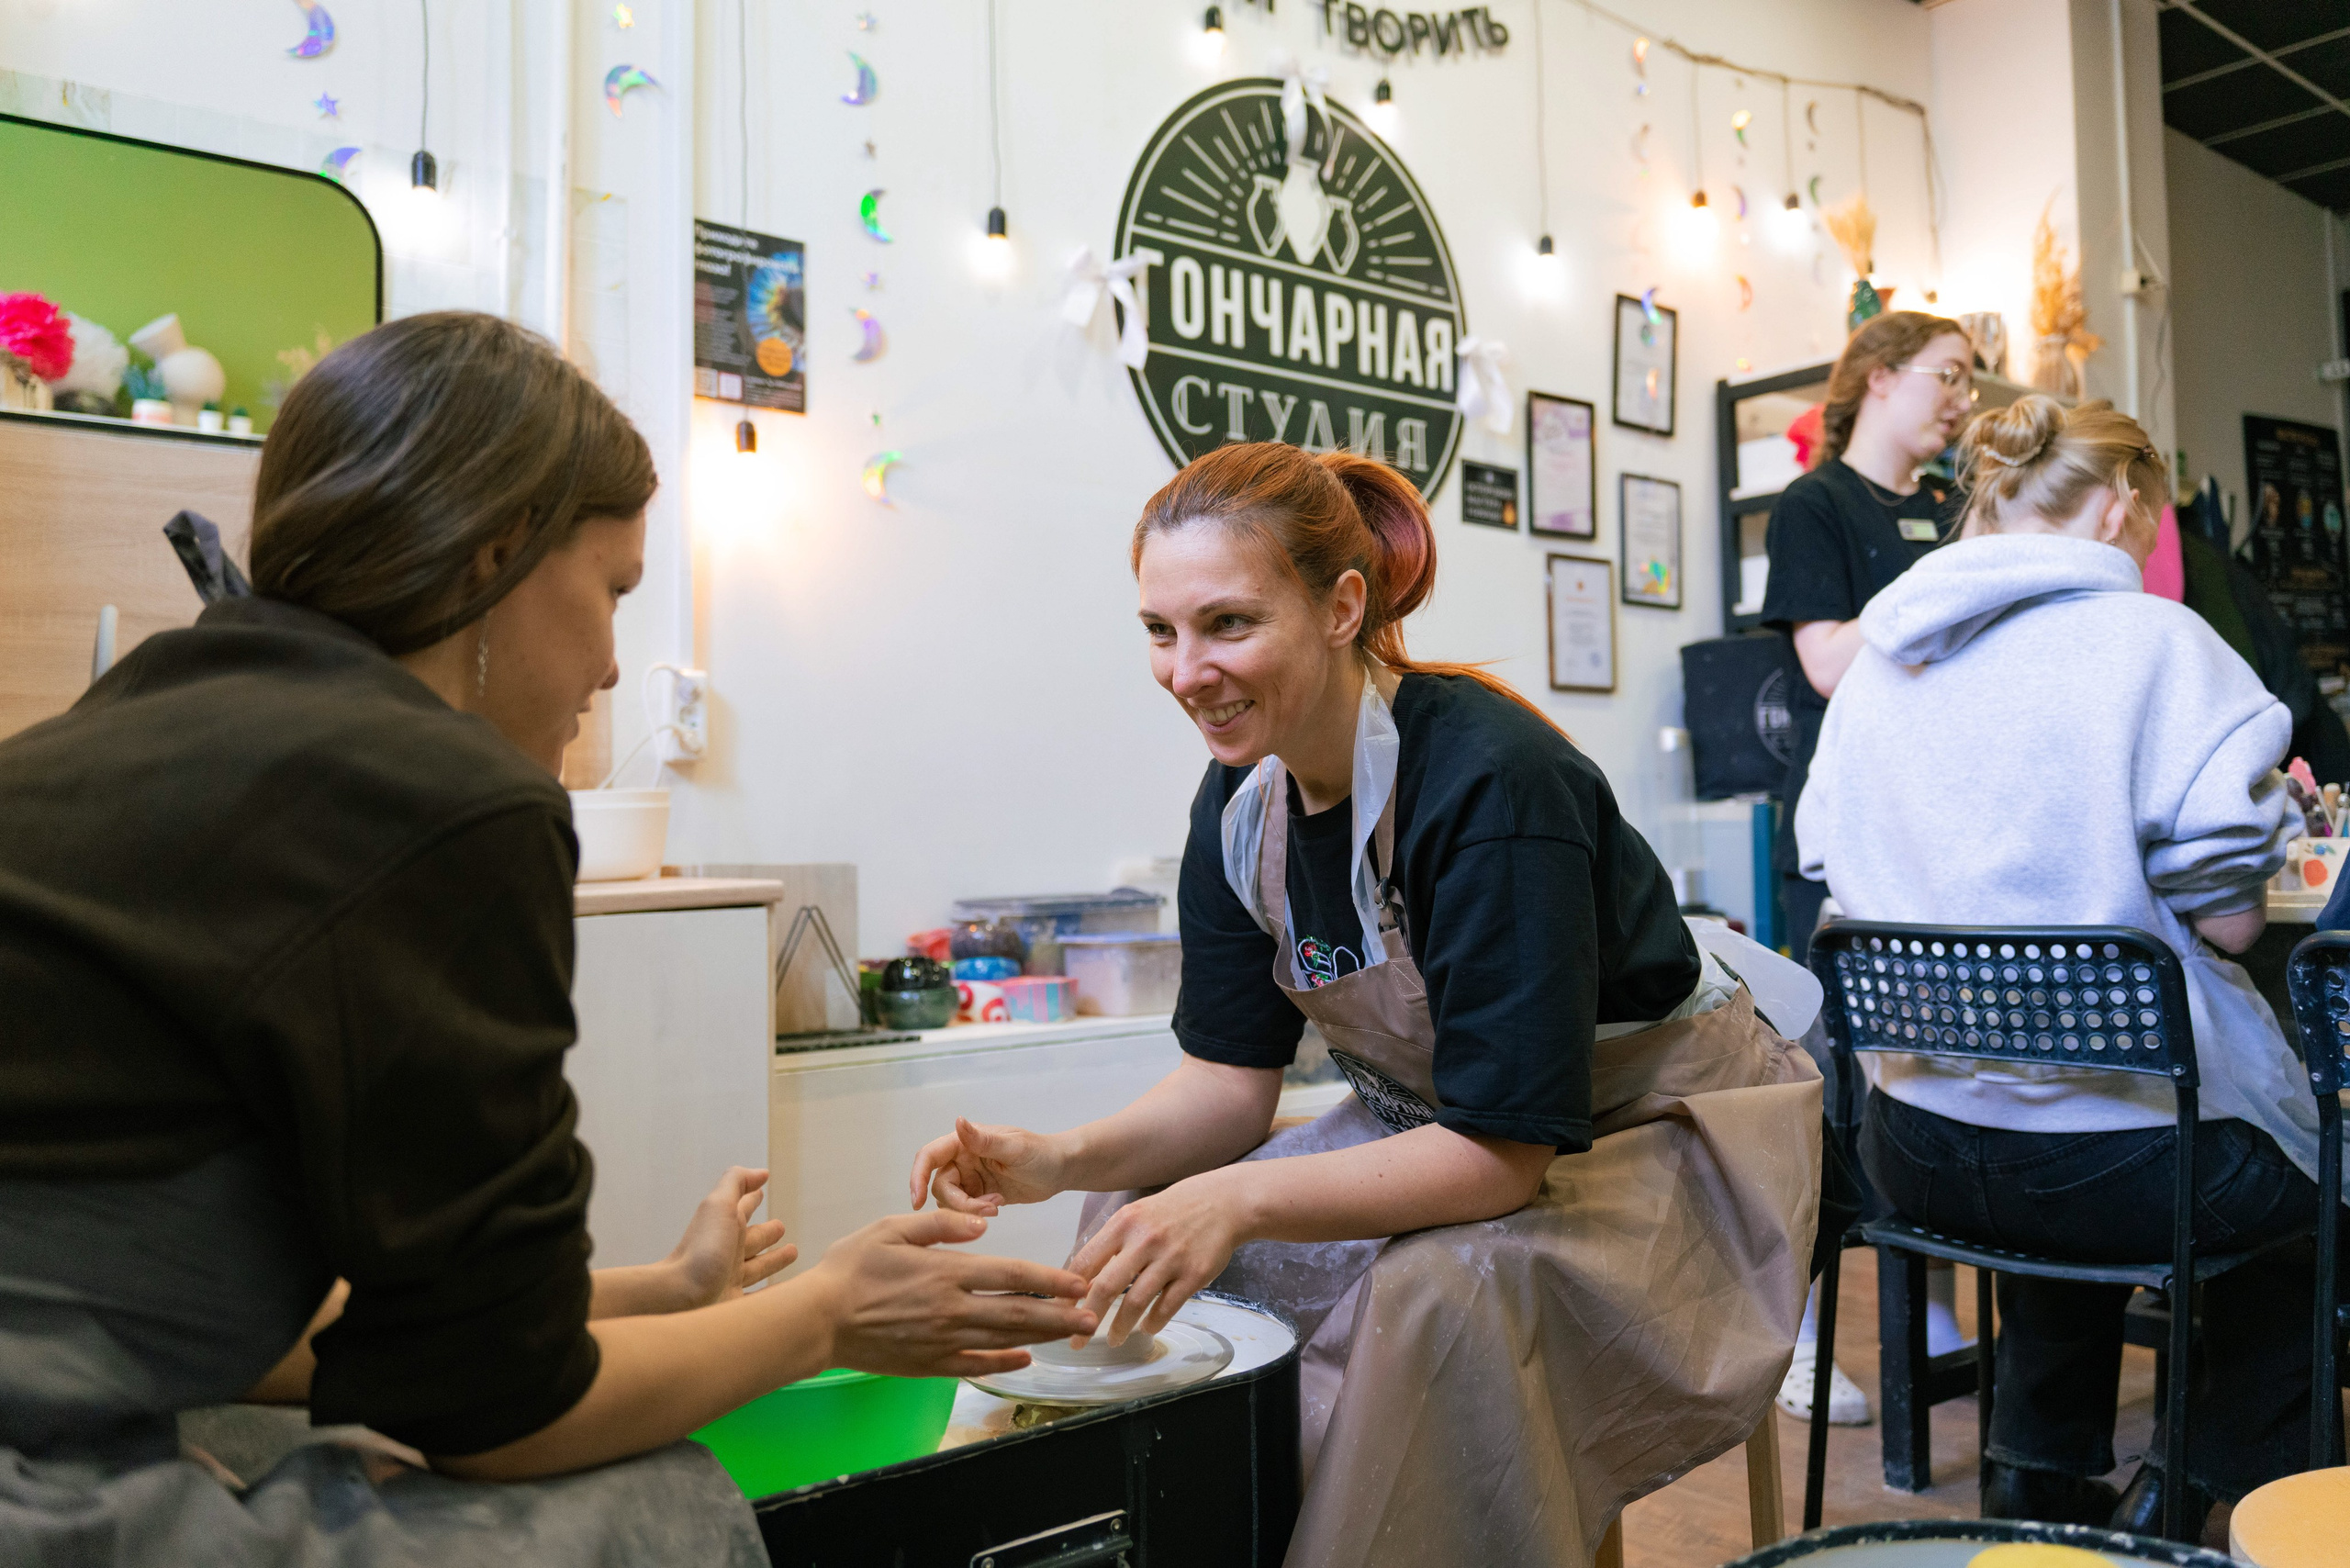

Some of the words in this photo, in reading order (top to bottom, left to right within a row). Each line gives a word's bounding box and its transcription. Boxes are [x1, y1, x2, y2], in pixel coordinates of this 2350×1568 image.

[1316, 0, 1509, 54] ТВОРИТЬ
[1134, 245, 1455, 393] ГОНЧАРНАЯ
[1170, 375, 1430, 473] СТУДИЯ
